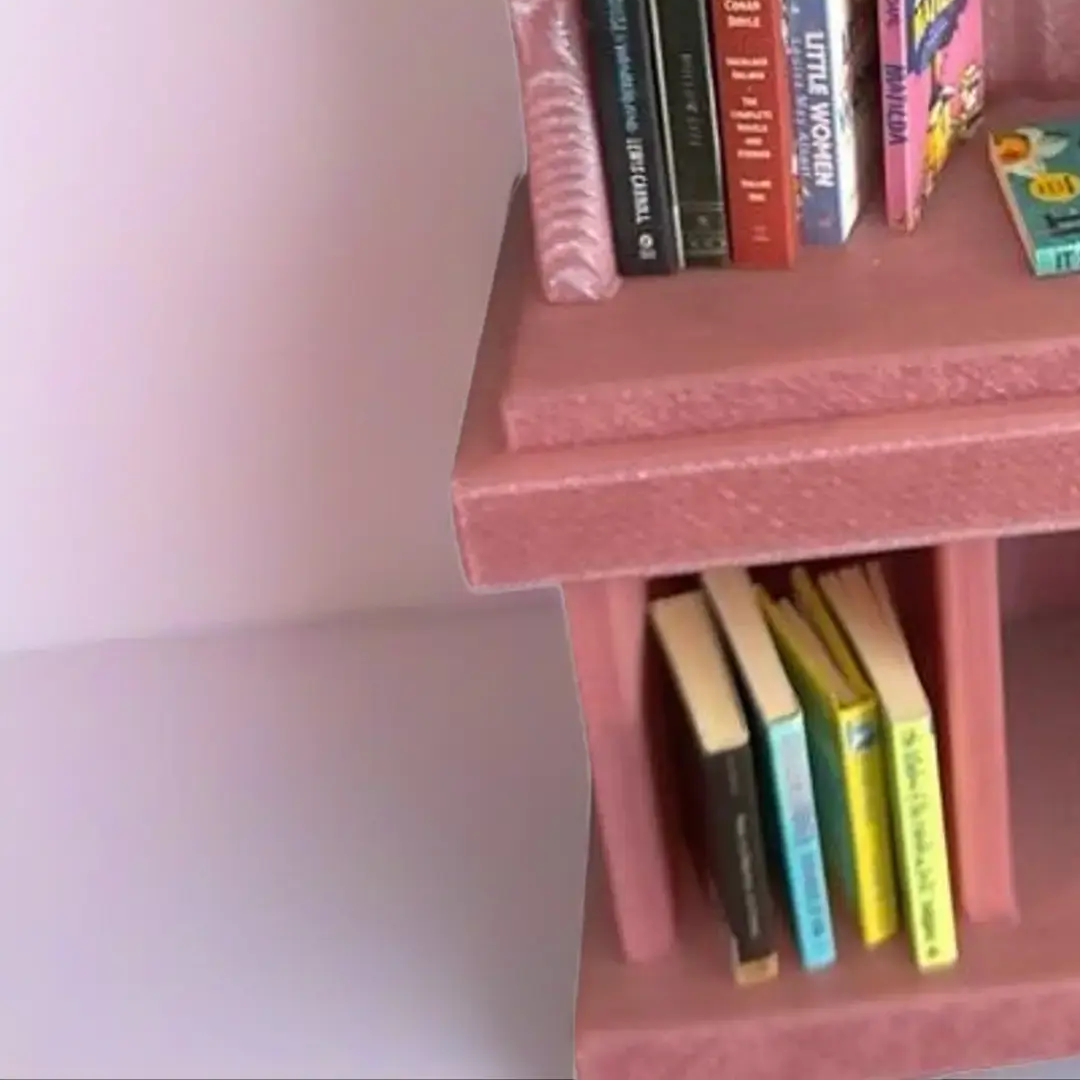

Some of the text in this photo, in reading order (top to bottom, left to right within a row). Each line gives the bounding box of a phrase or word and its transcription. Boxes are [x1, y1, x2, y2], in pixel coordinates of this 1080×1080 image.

[803, 31, 836, 188] LITTLE WOMEN
[1055, 251, 1074, 270] IT
